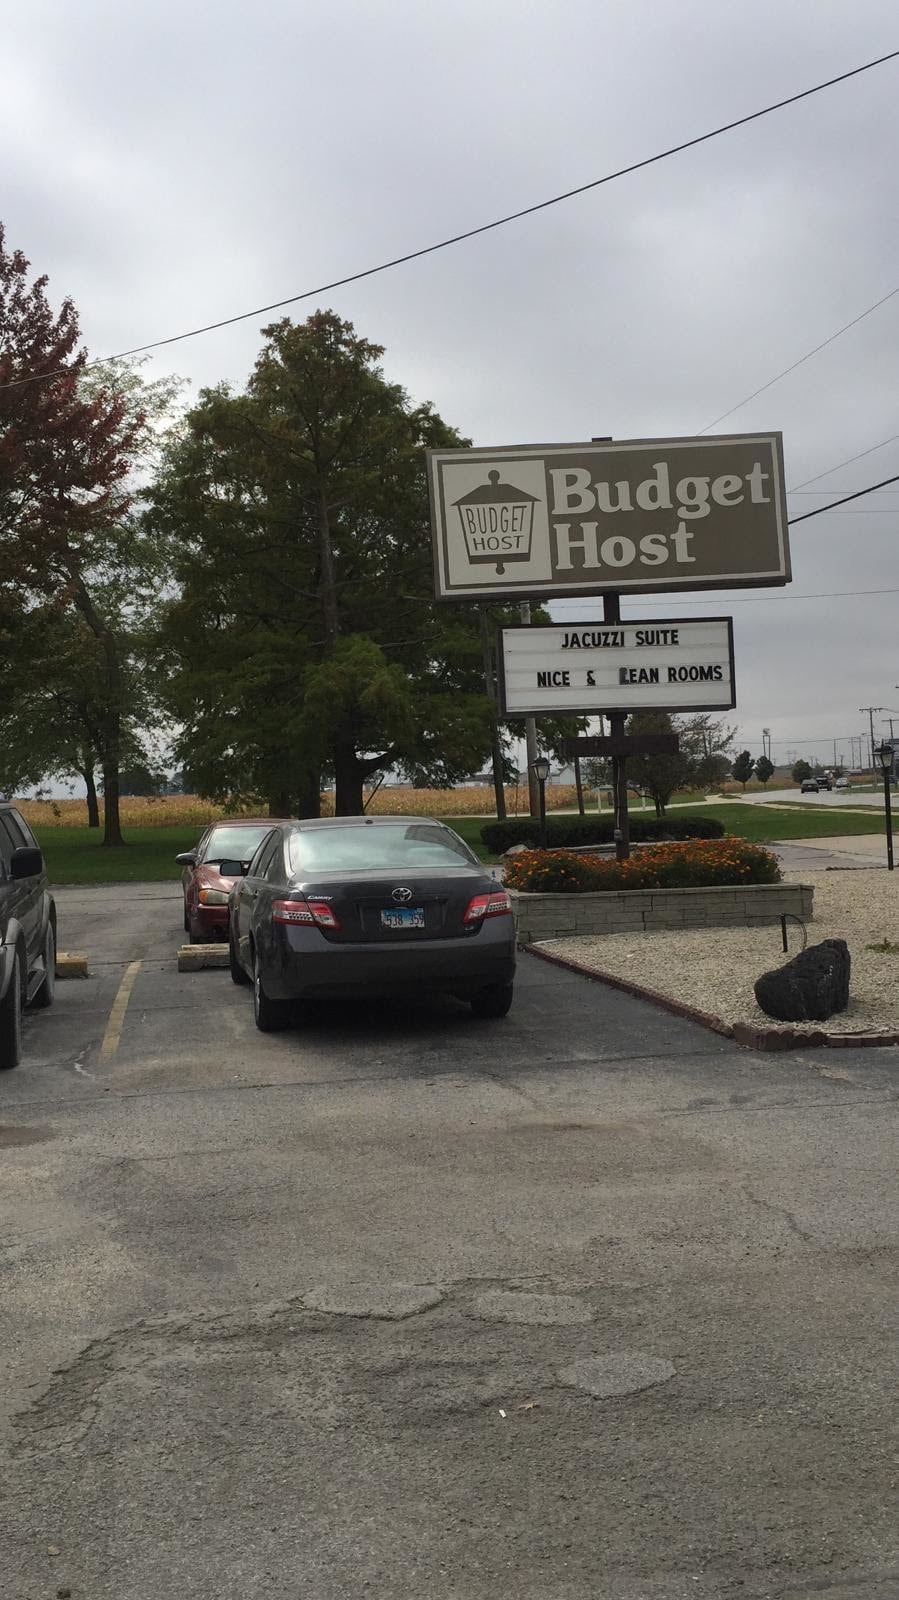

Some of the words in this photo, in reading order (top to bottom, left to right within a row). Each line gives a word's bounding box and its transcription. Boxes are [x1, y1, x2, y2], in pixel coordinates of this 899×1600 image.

[549, 462, 771, 520] Budget
[465, 505, 528, 535] BUDGET
[473, 535, 526, 552] HOST
[552, 521, 697, 570] Host
[561, 631, 626, 649] JACUZZI
[635, 629, 680, 647] SUITE
[536, 671, 571, 688] NICE
[586, 670, 597, 687] &
[667, 665, 723, 683] ROOMS
